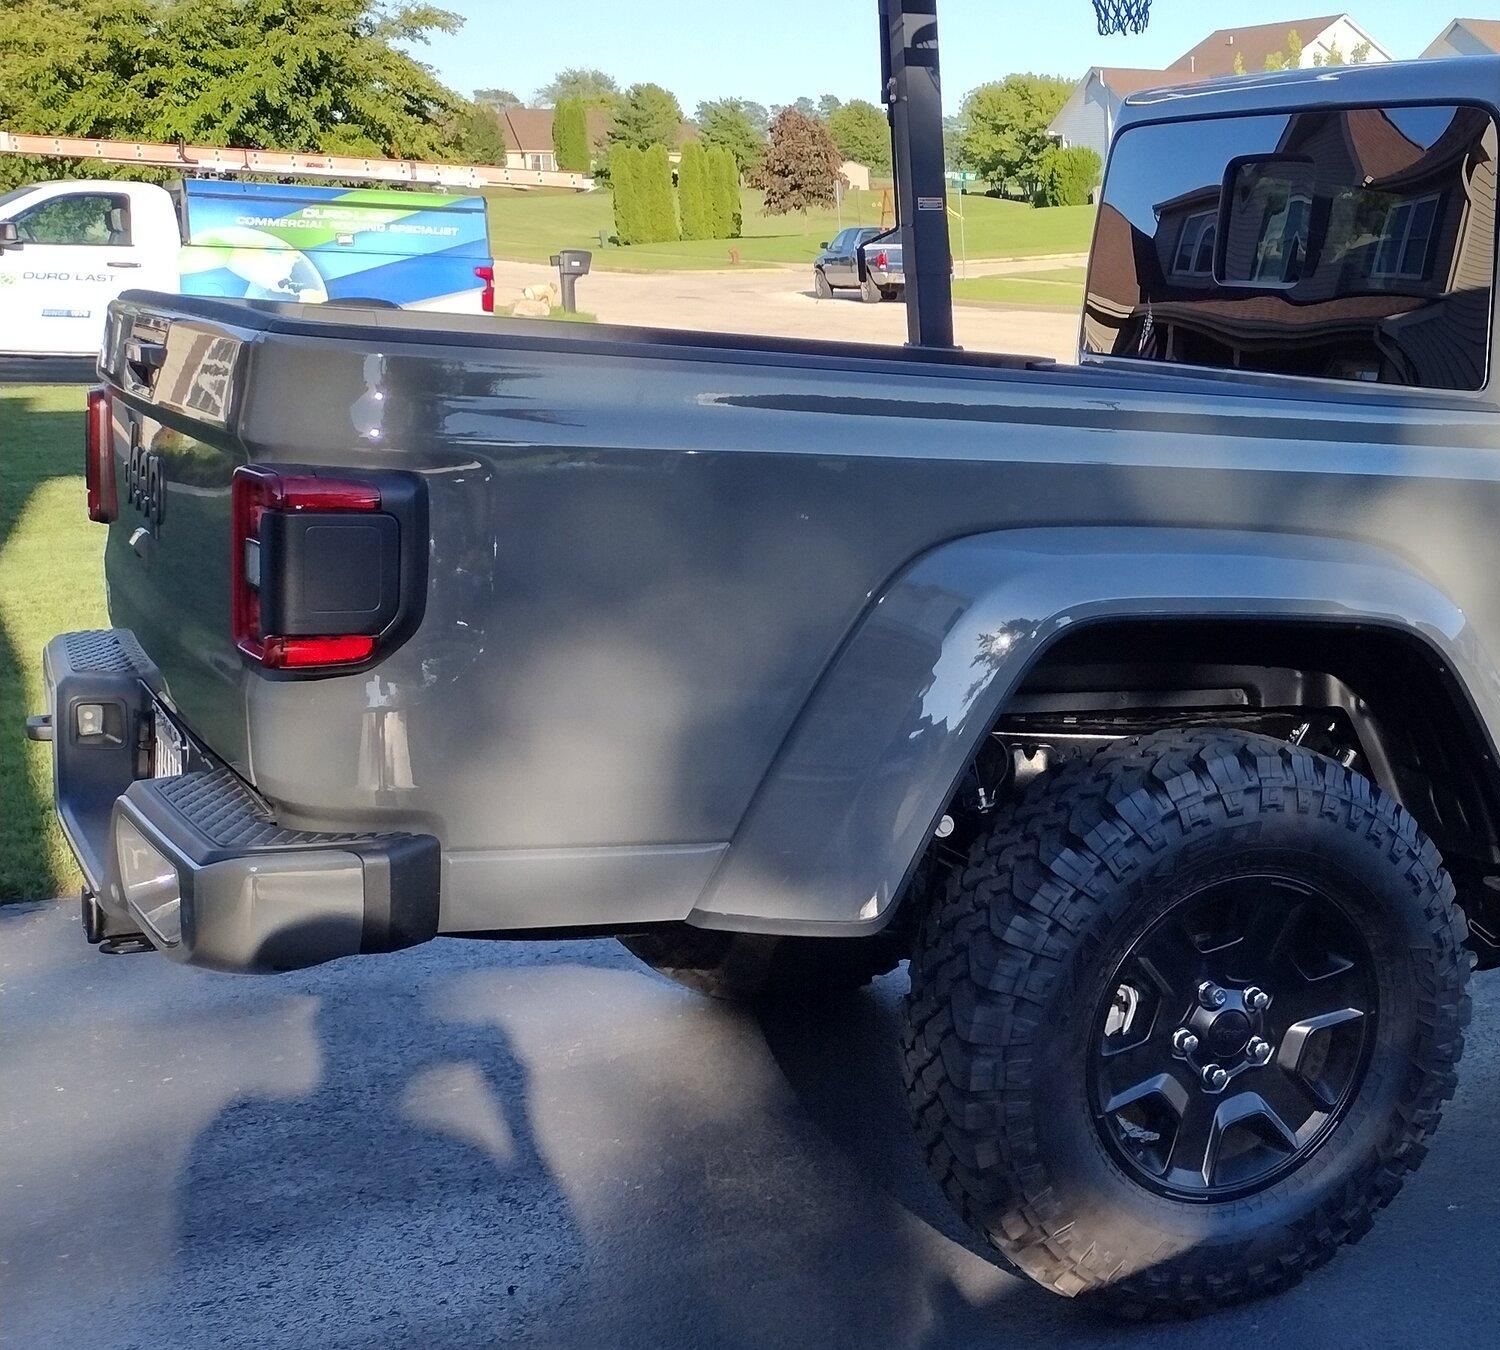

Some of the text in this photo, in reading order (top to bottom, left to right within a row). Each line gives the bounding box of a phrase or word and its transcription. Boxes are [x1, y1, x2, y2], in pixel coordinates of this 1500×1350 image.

[235, 216, 325, 229] COMMERCIAL
[388, 223, 460, 236] SPECIALIST
[23, 272, 115, 282] DURO LAST
